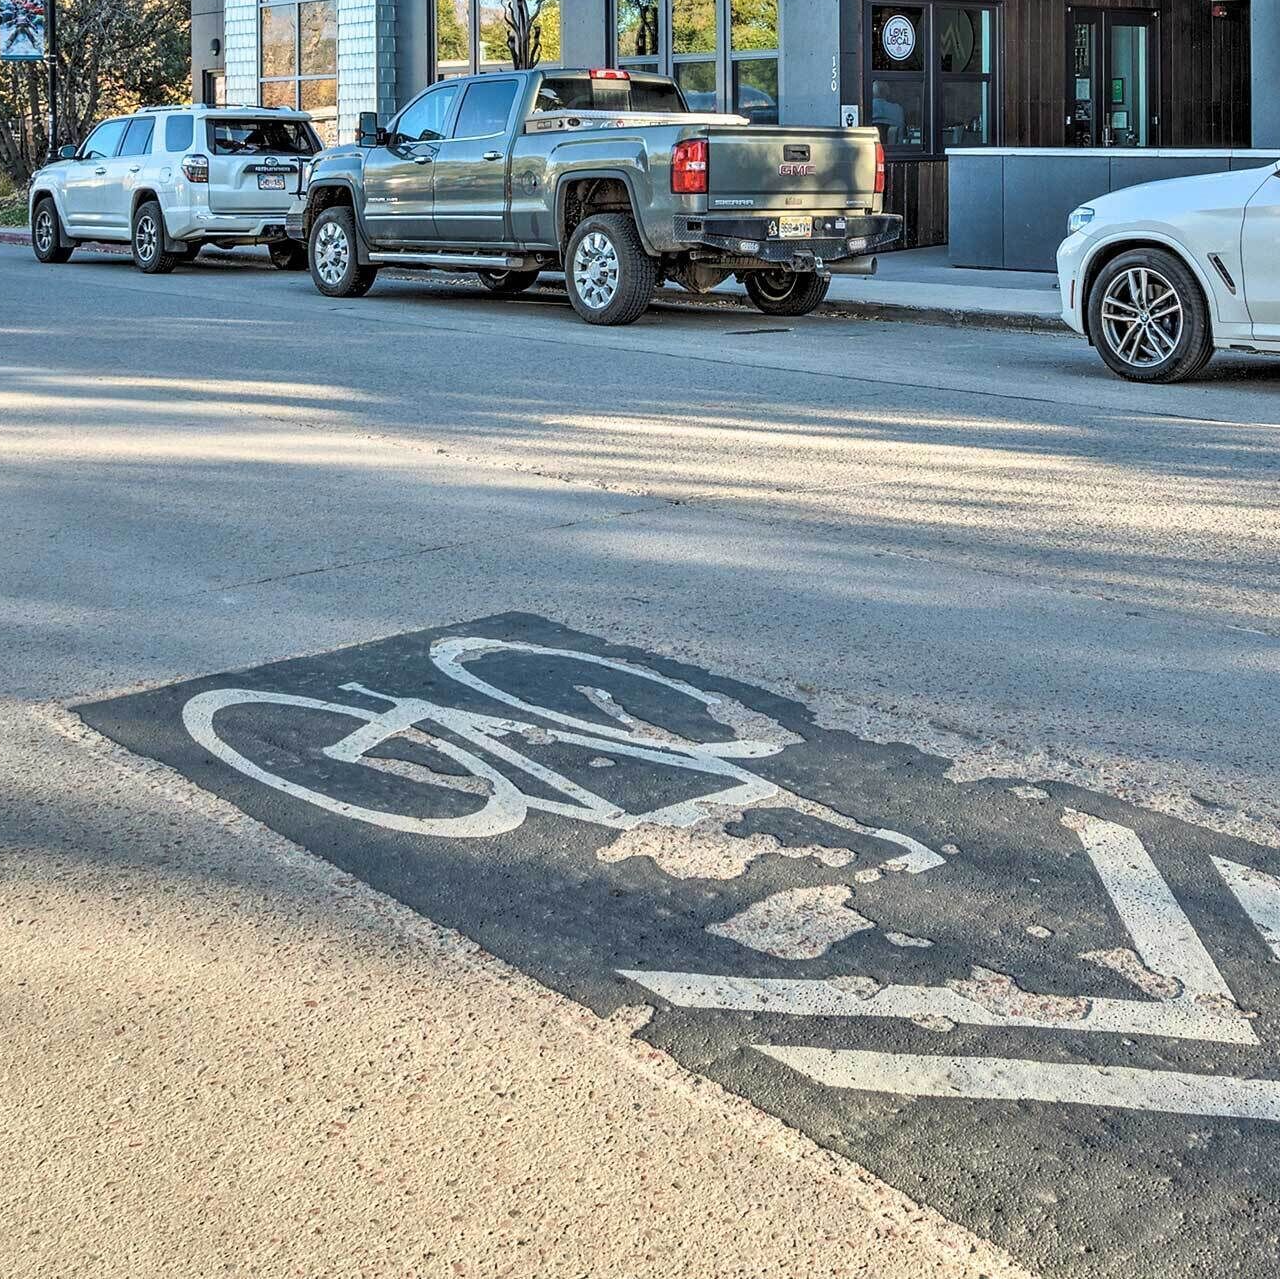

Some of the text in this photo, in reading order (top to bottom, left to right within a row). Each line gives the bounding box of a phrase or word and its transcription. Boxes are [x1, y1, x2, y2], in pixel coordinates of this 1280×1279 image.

[890, 28, 908, 37] LOVE
[886, 36, 911, 46] LOCAL
[779, 164, 817, 176] GMC
